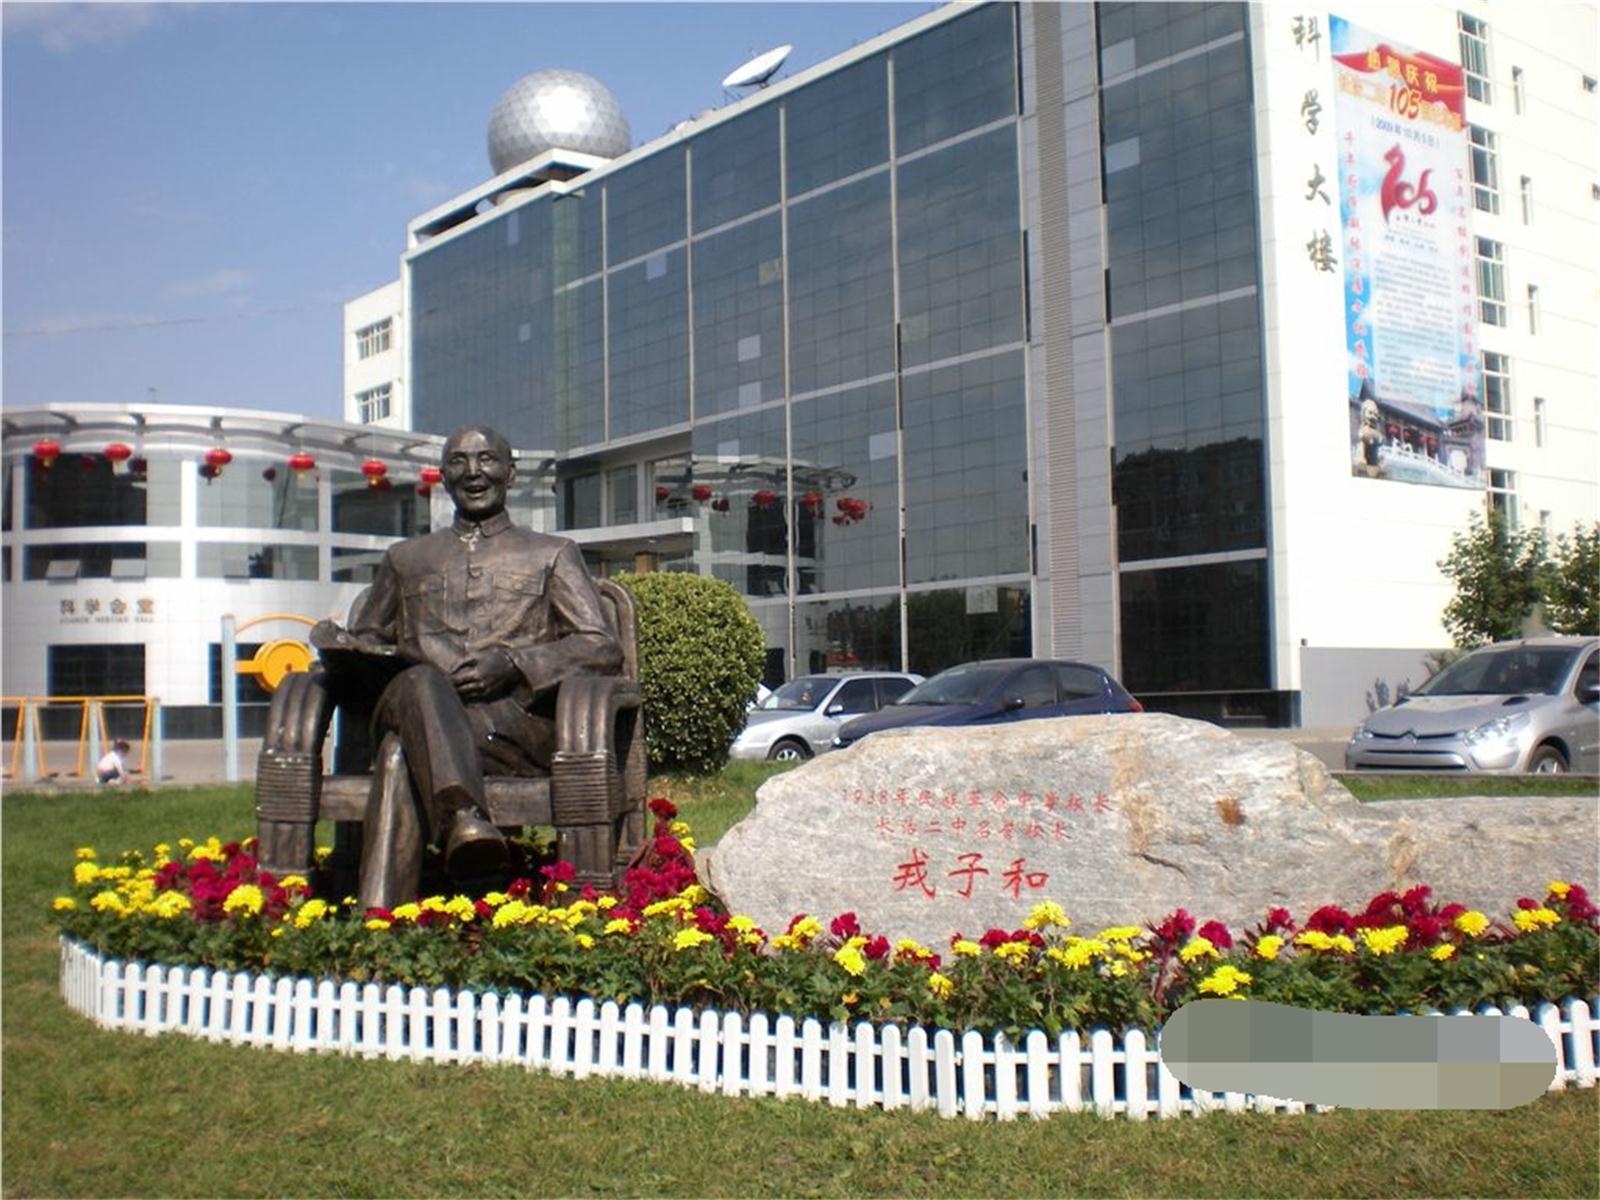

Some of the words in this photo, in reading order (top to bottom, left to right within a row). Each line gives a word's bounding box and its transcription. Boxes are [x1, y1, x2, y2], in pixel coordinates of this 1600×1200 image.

[1292, 15, 1338, 274] 科学大楼
[893, 849, 1049, 899] 戎子和
